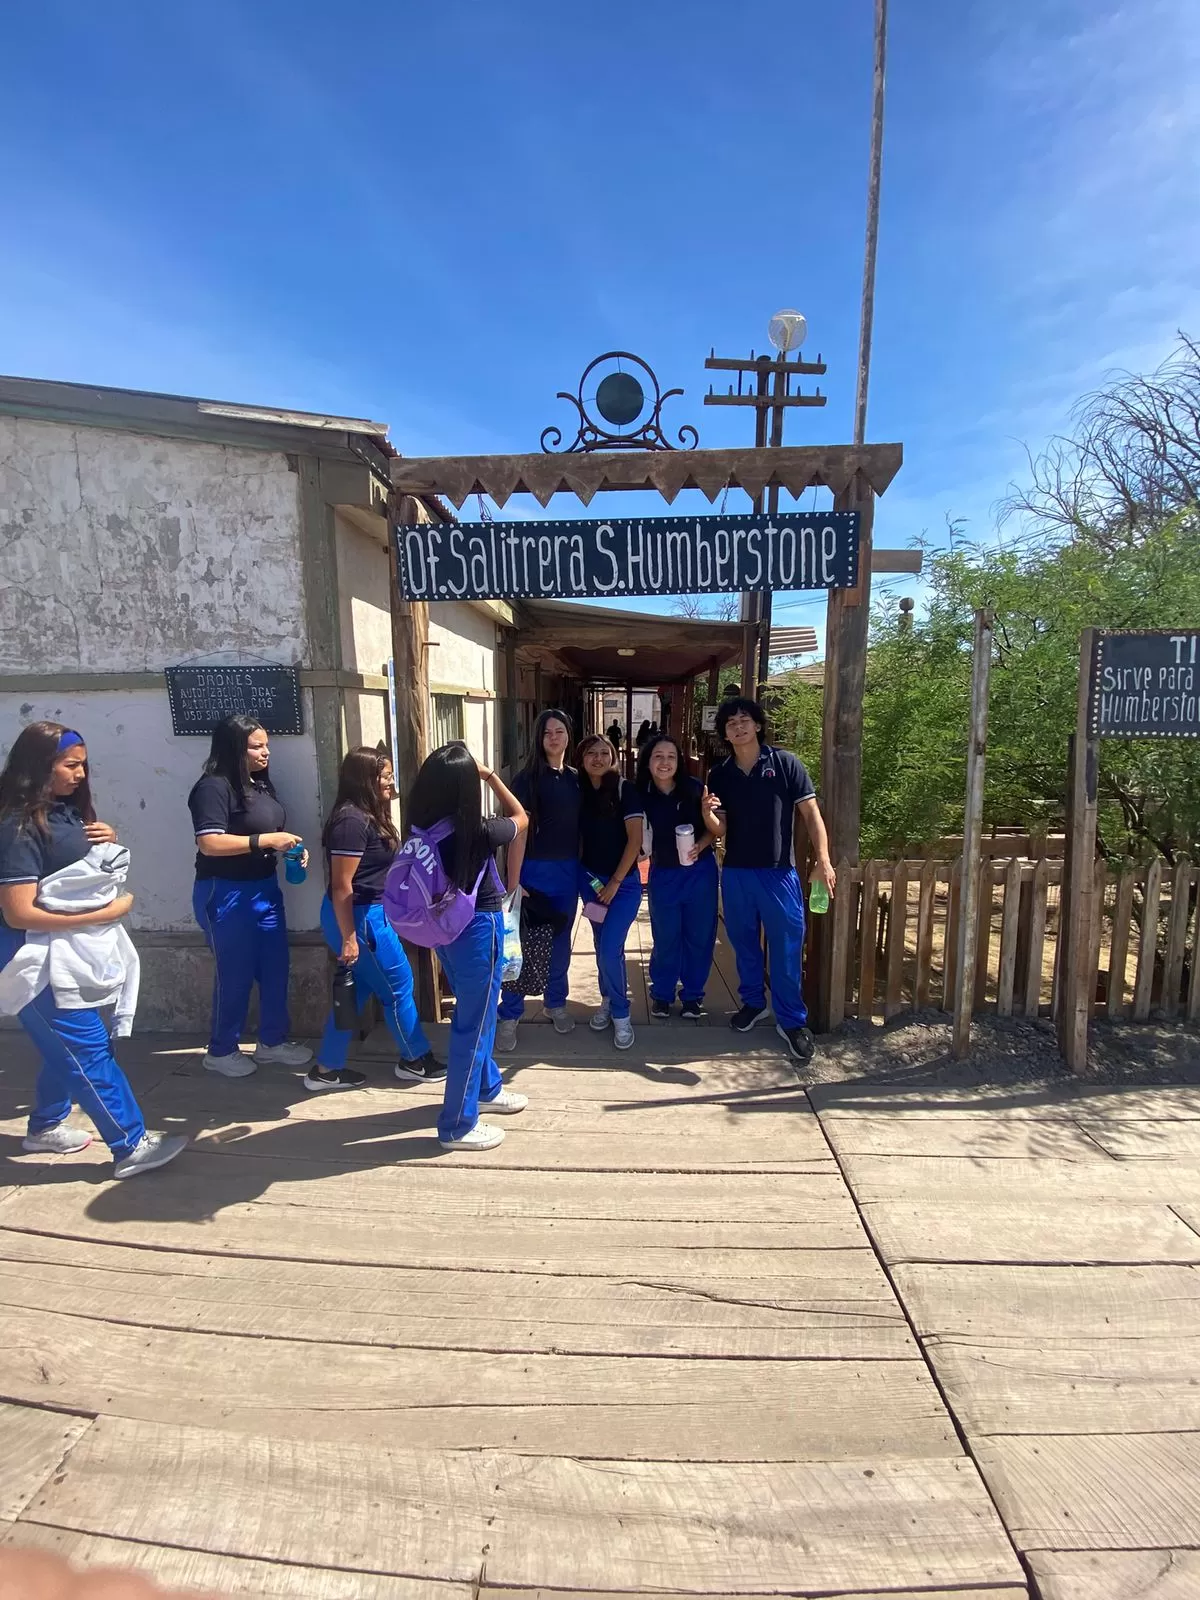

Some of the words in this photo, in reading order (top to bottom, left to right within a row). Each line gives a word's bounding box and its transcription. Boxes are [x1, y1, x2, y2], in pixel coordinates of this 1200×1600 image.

[197, 674, 254, 687] DRONES
[1102, 666, 1153, 692] Sirve
[251, 686, 277, 697] DGAC
[251, 697, 274, 709] CMS
